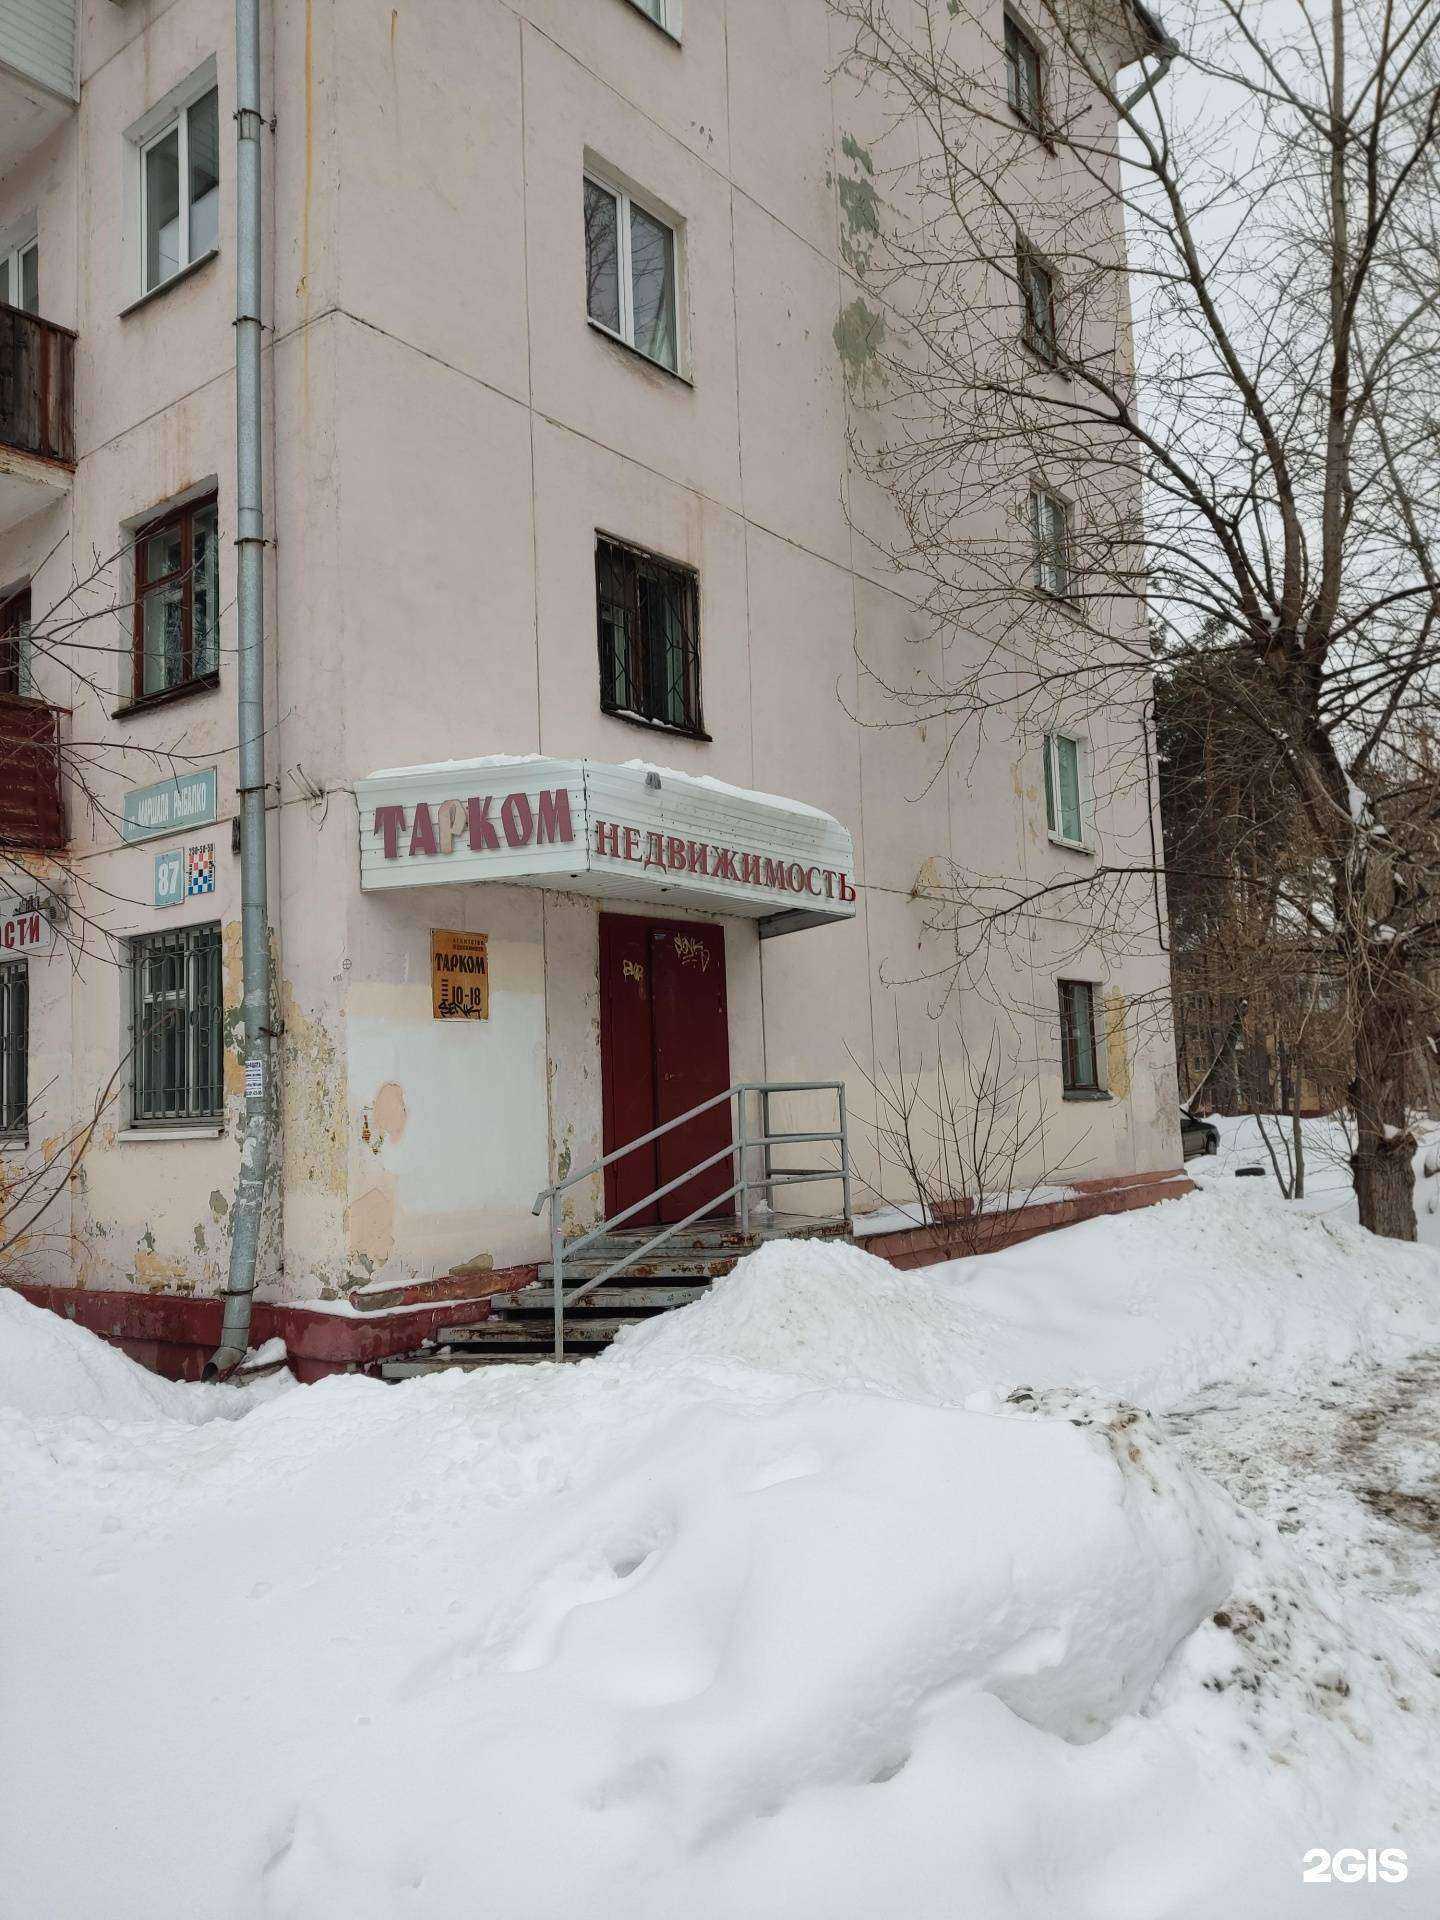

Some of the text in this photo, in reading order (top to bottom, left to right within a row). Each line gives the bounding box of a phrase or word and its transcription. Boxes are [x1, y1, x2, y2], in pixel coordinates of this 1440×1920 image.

[173, 782, 207, 820] РЫБАЛКО
[374, 788, 574, 859] ТАРКОМ
[158, 860, 180, 896] 87
[595, 820, 857, 902] НЕДВИЖИМОСТЬ
[0, 914, 39, 949] СТИ
[435, 953, 486, 975] ТАРКОМ
[451, 986, 481, 1006] 10-18
